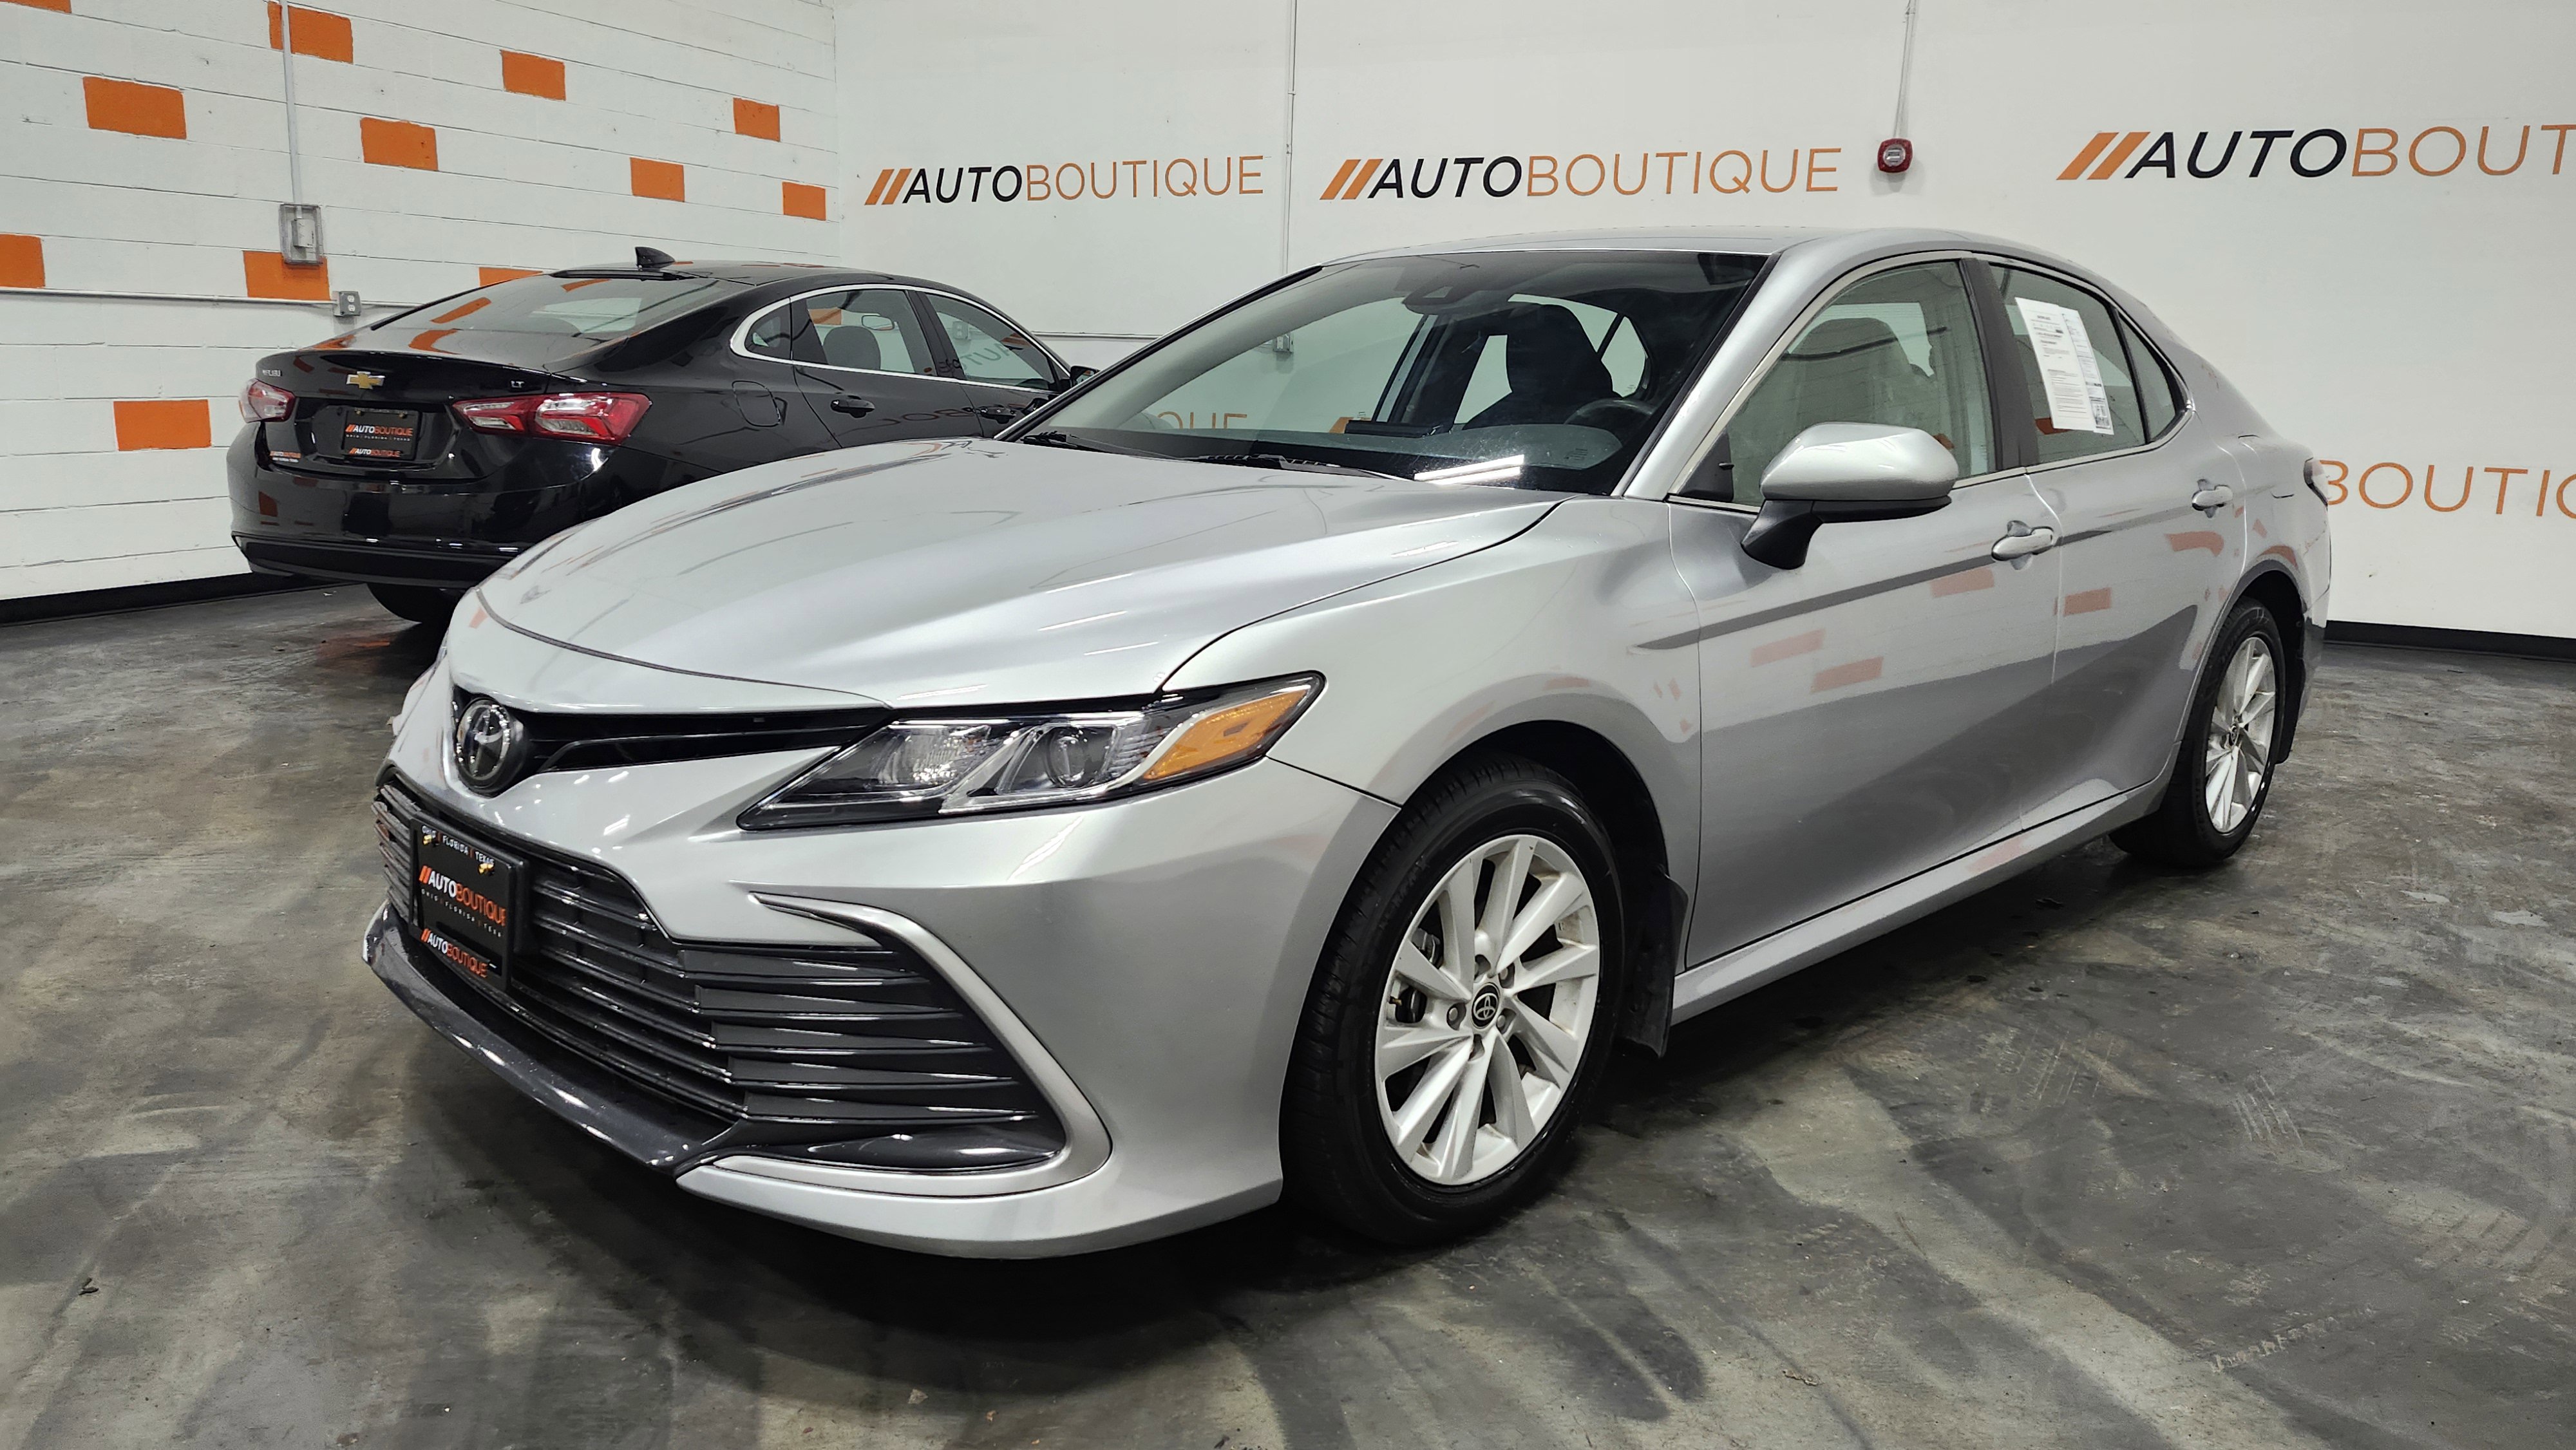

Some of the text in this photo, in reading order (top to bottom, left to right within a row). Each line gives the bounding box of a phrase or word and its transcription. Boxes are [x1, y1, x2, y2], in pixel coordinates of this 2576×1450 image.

[902, 155, 1264, 203] AUTOBOUTIQUE
[1368, 148, 1842, 199] AUTOBOUTIQUE
[442, 835, 469, 855] FLORIDA
